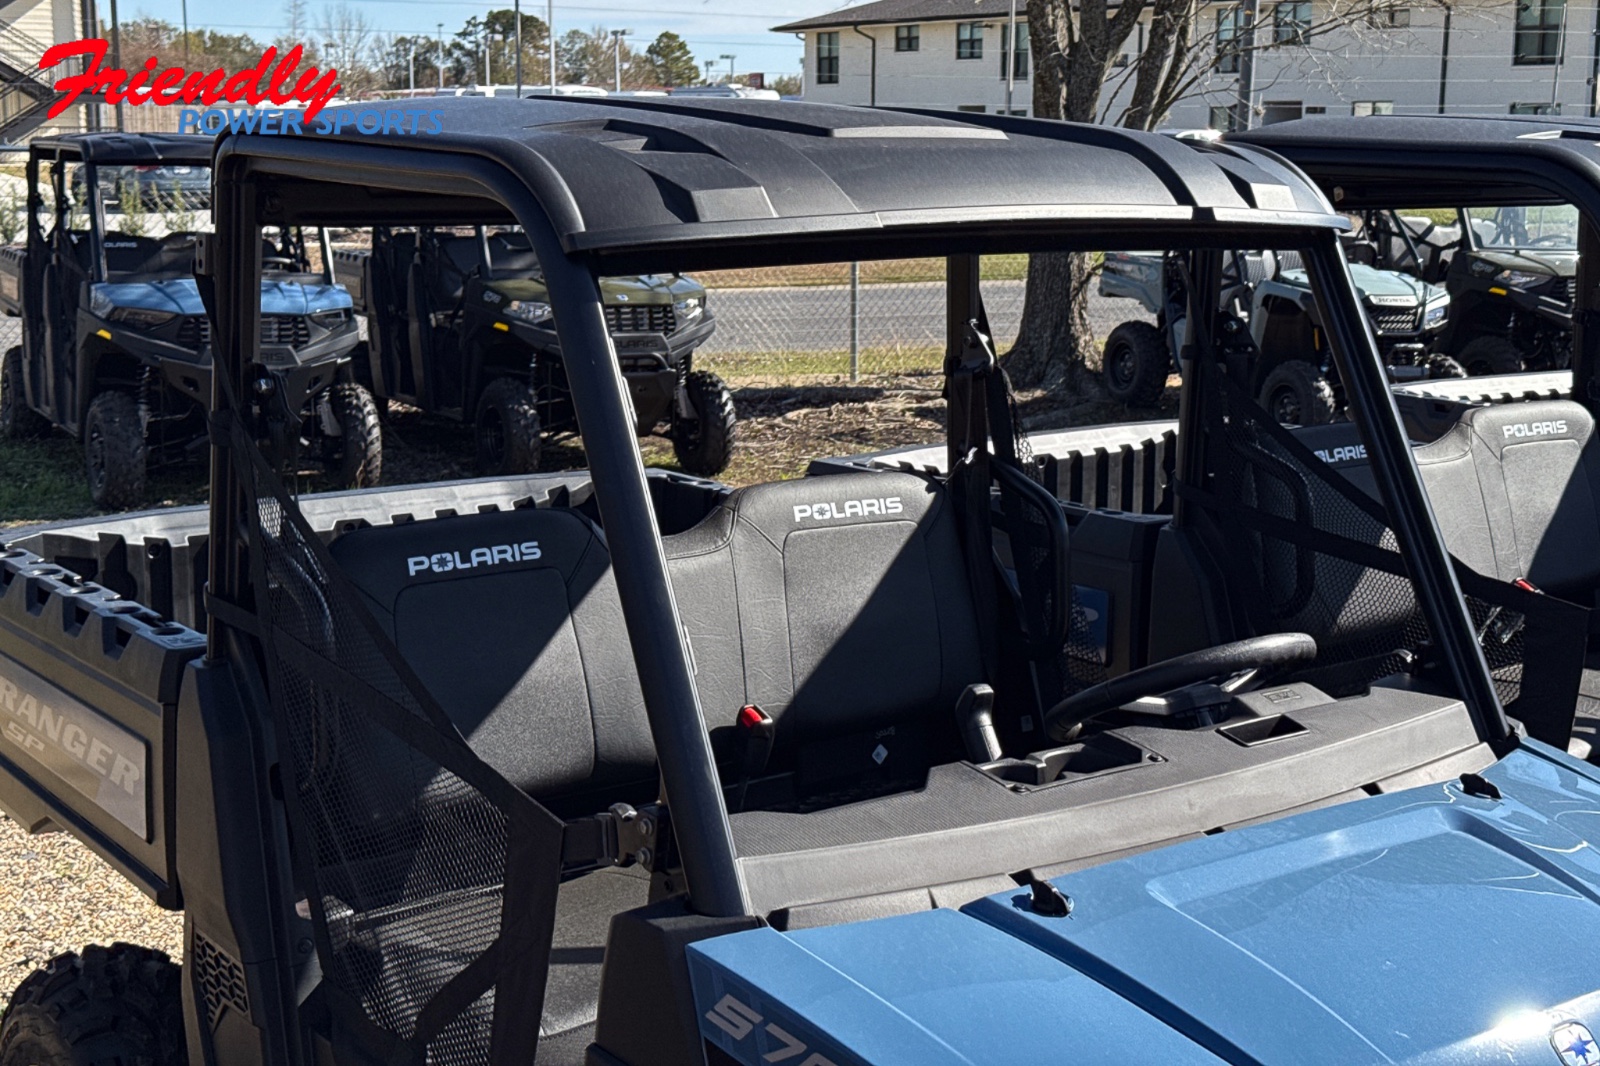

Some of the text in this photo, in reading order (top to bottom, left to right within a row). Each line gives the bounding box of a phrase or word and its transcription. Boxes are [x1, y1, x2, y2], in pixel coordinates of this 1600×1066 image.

[1502, 420, 1568, 438] POLARIS
[1313, 444, 1368, 463] OLARIS
[792, 496, 904, 523] POLARIS
[407, 541, 542, 577] POLARIS
[0, 675, 141, 796] RANGER
[7, 720, 46, 751] SP
